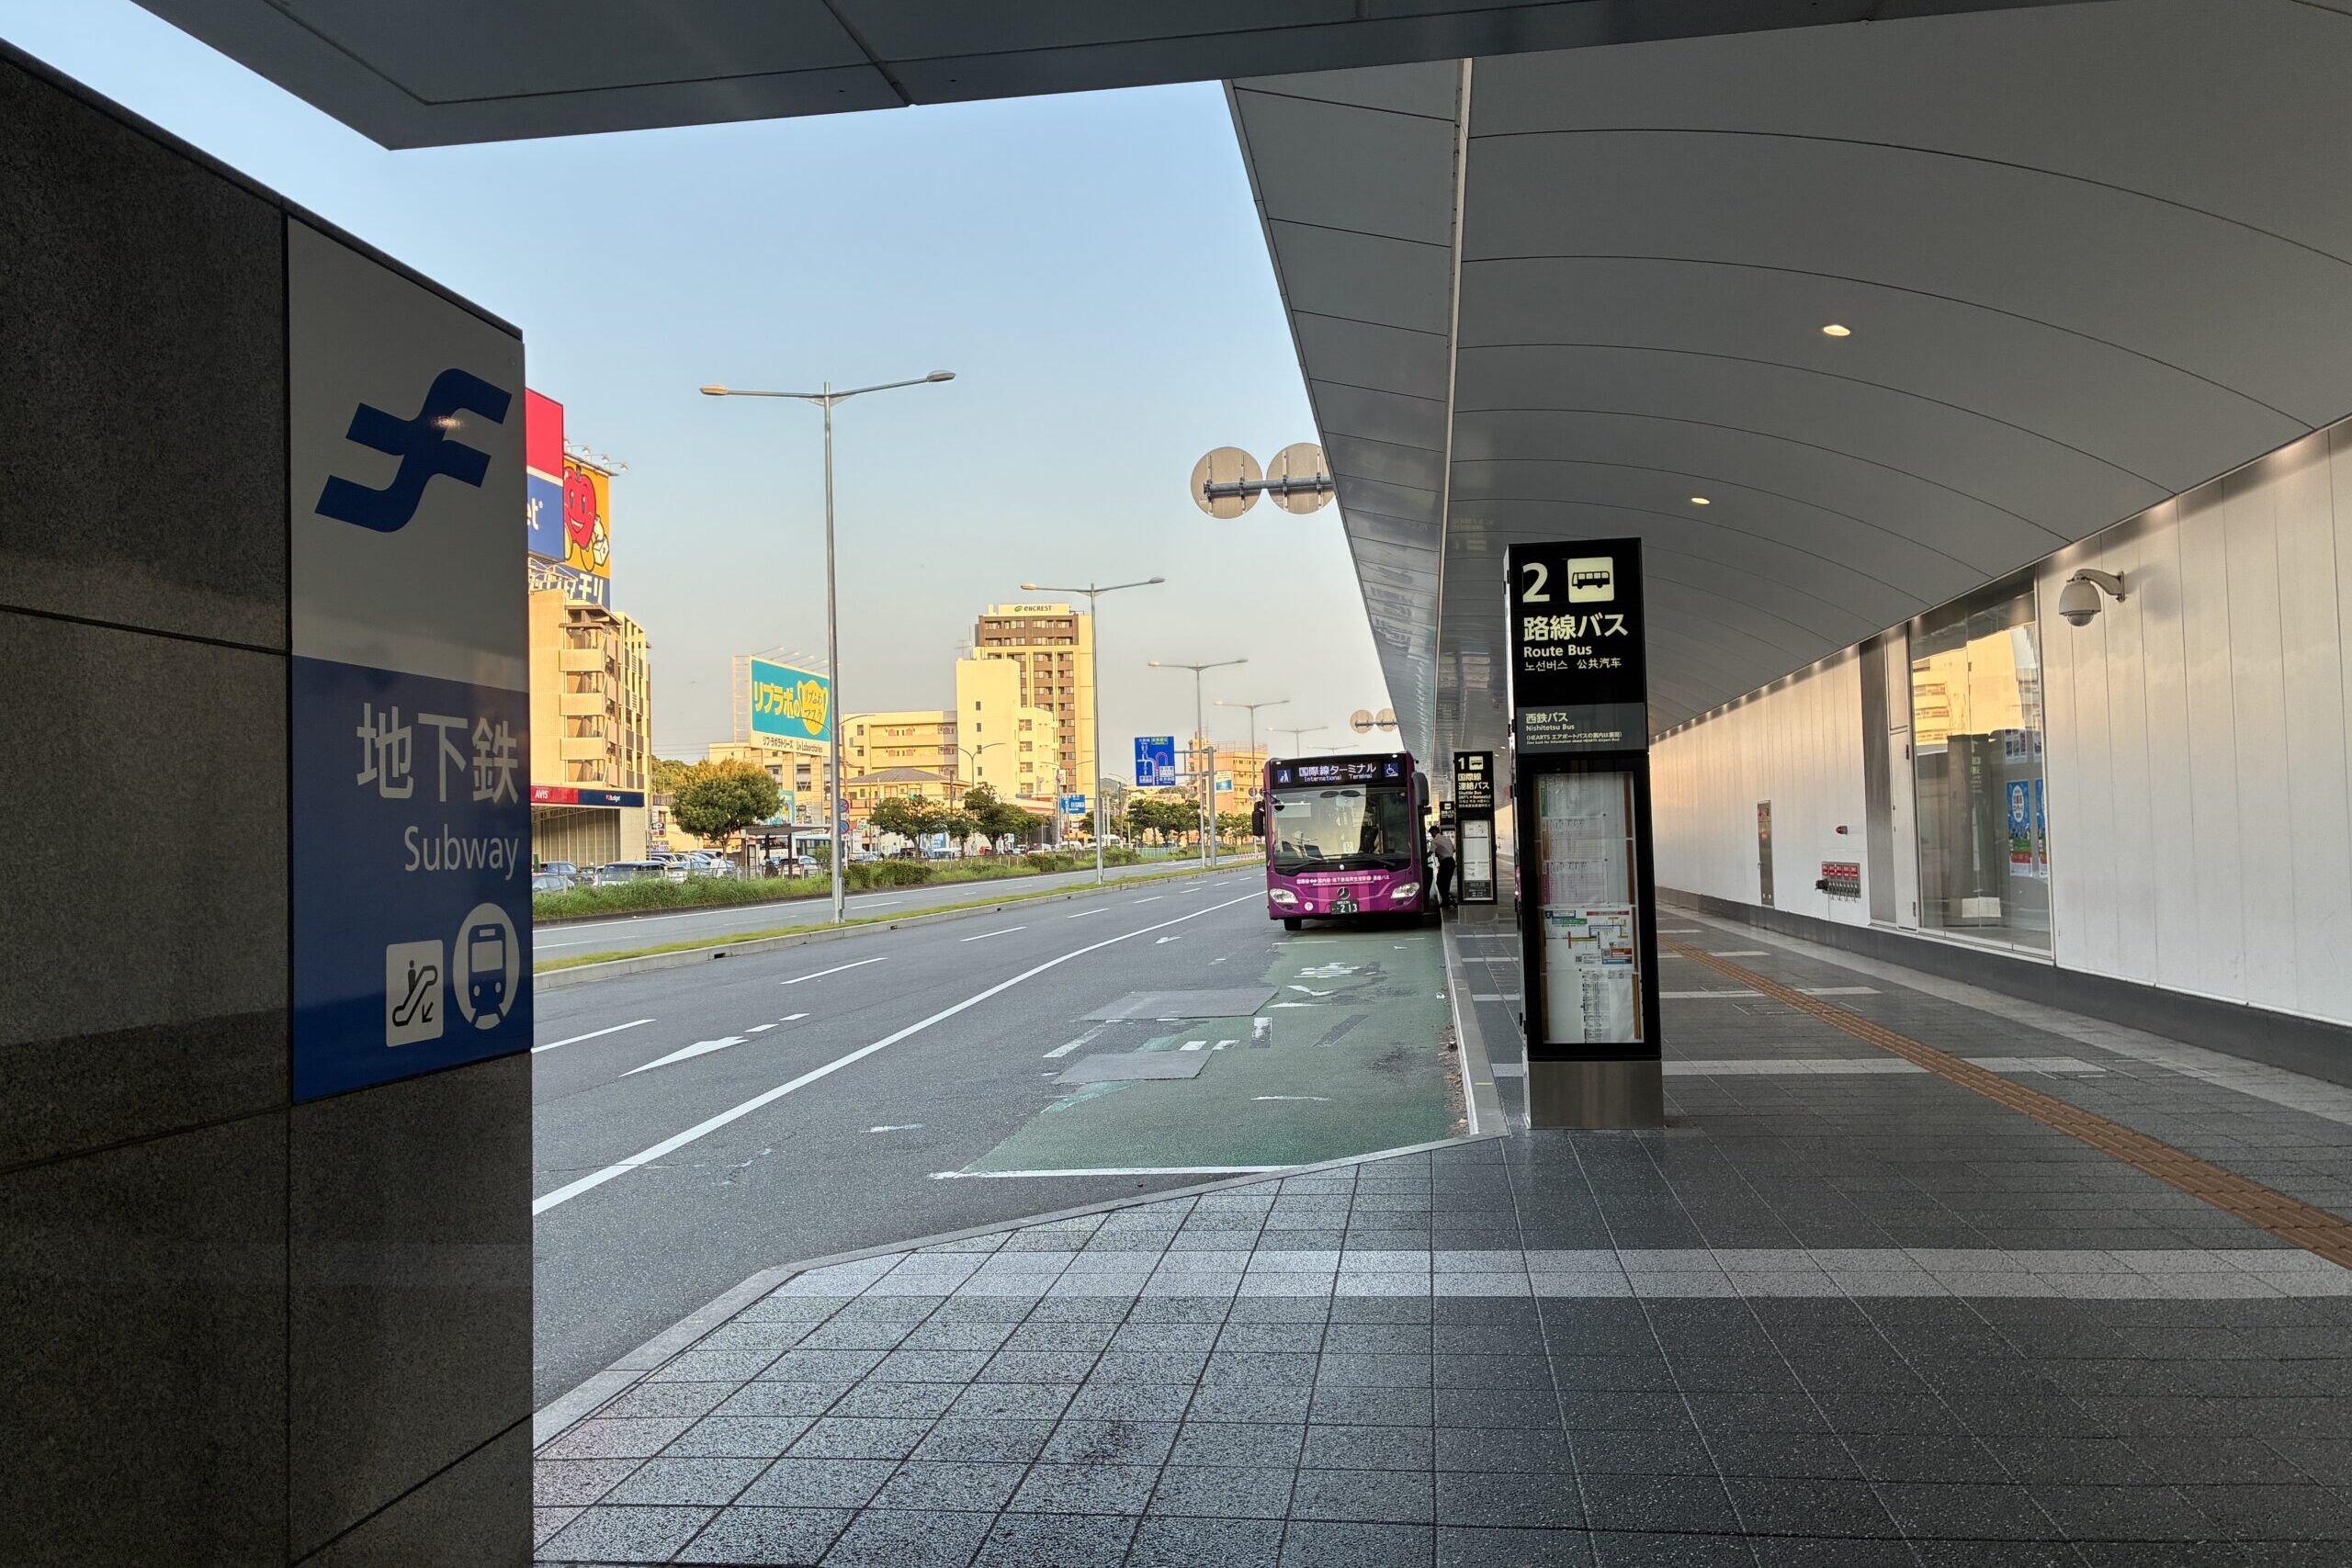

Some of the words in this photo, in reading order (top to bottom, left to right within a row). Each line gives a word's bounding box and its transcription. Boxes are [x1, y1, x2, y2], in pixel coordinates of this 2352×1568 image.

[1522, 562, 1551, 604] 2
[1523, 612, 1629, 642] 路線バス
[1523, 646, 1564, 658] Route
[1567, 644, 1592, 656] Bus
[1524, 660, 1568, 671] 노선버스
[1577, 658, 1623, 670] 公共汽车
[1525, 712, 1568, 724] 西鉄バス
[356, 702, 519, 805] 地下鉄
[1298, 763, 1376, 777] 国際線ターミナル
[1457, 757, 1465, 770] 1
[535, 789, 548, 799] AVIS
[403, 823, 519, 882] Subway
